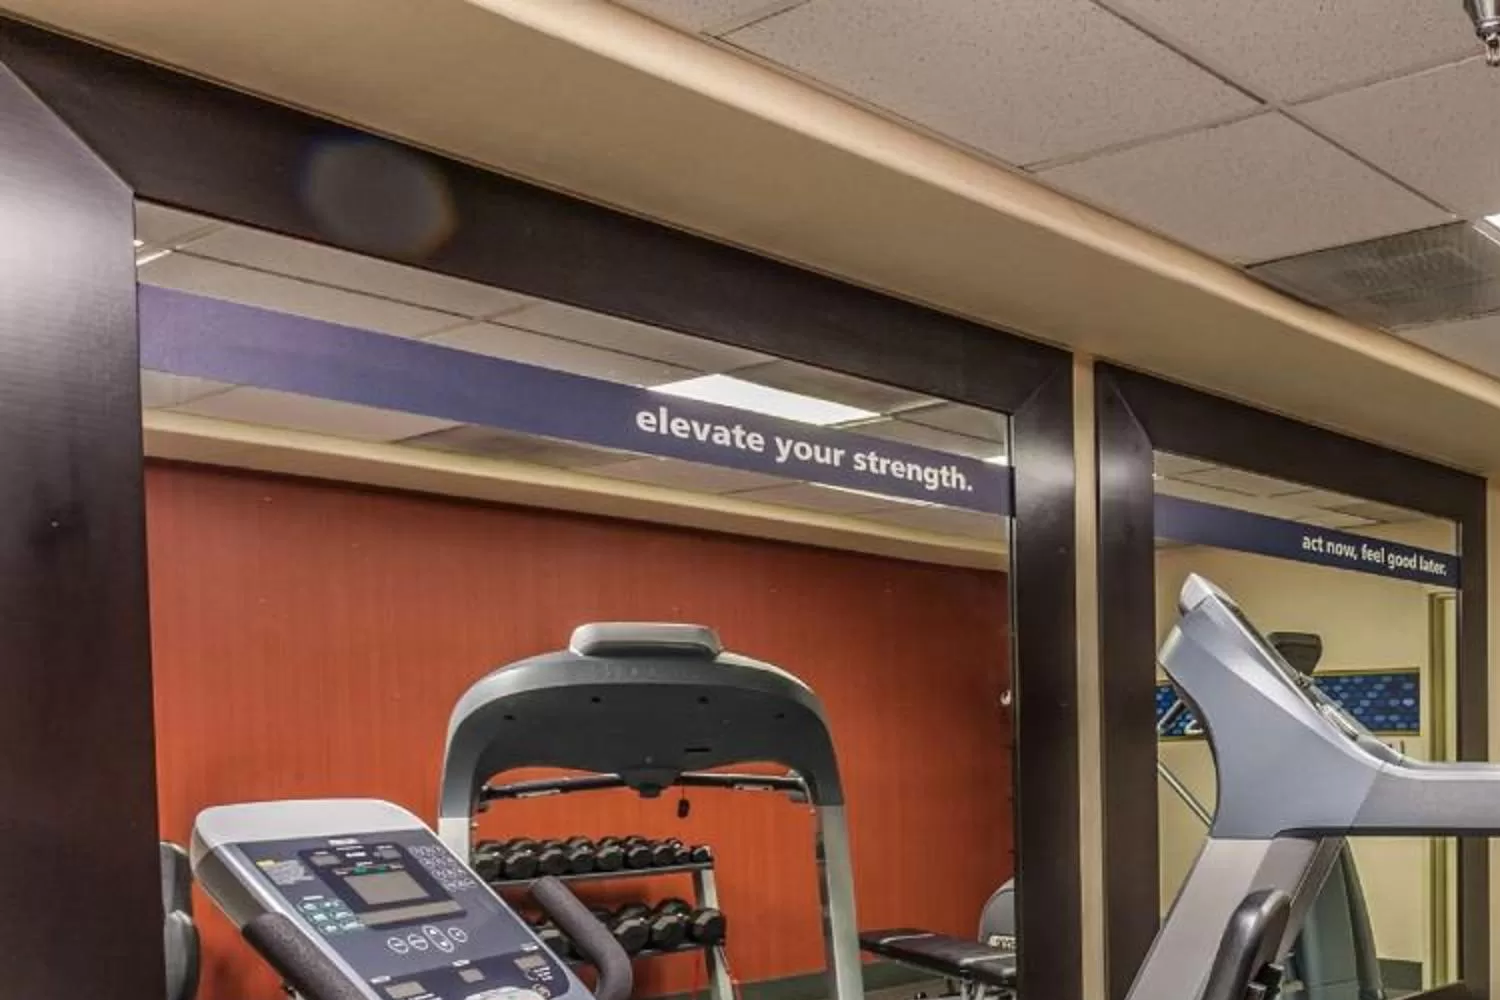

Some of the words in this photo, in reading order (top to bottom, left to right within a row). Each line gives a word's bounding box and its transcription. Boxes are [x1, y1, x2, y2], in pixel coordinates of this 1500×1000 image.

[636, 407, 765, 453] elevate
[775, 435, 845, 465] your
[853, 450, 973, 492] strength.
[1302, 535, 1323, 553] act
[1326, 541, 1358, 560] now,
[1361, 543, 1385, 565] feel
[1388, 553, 1417, 569] good
[1420, 554, 1447, 576] later.
